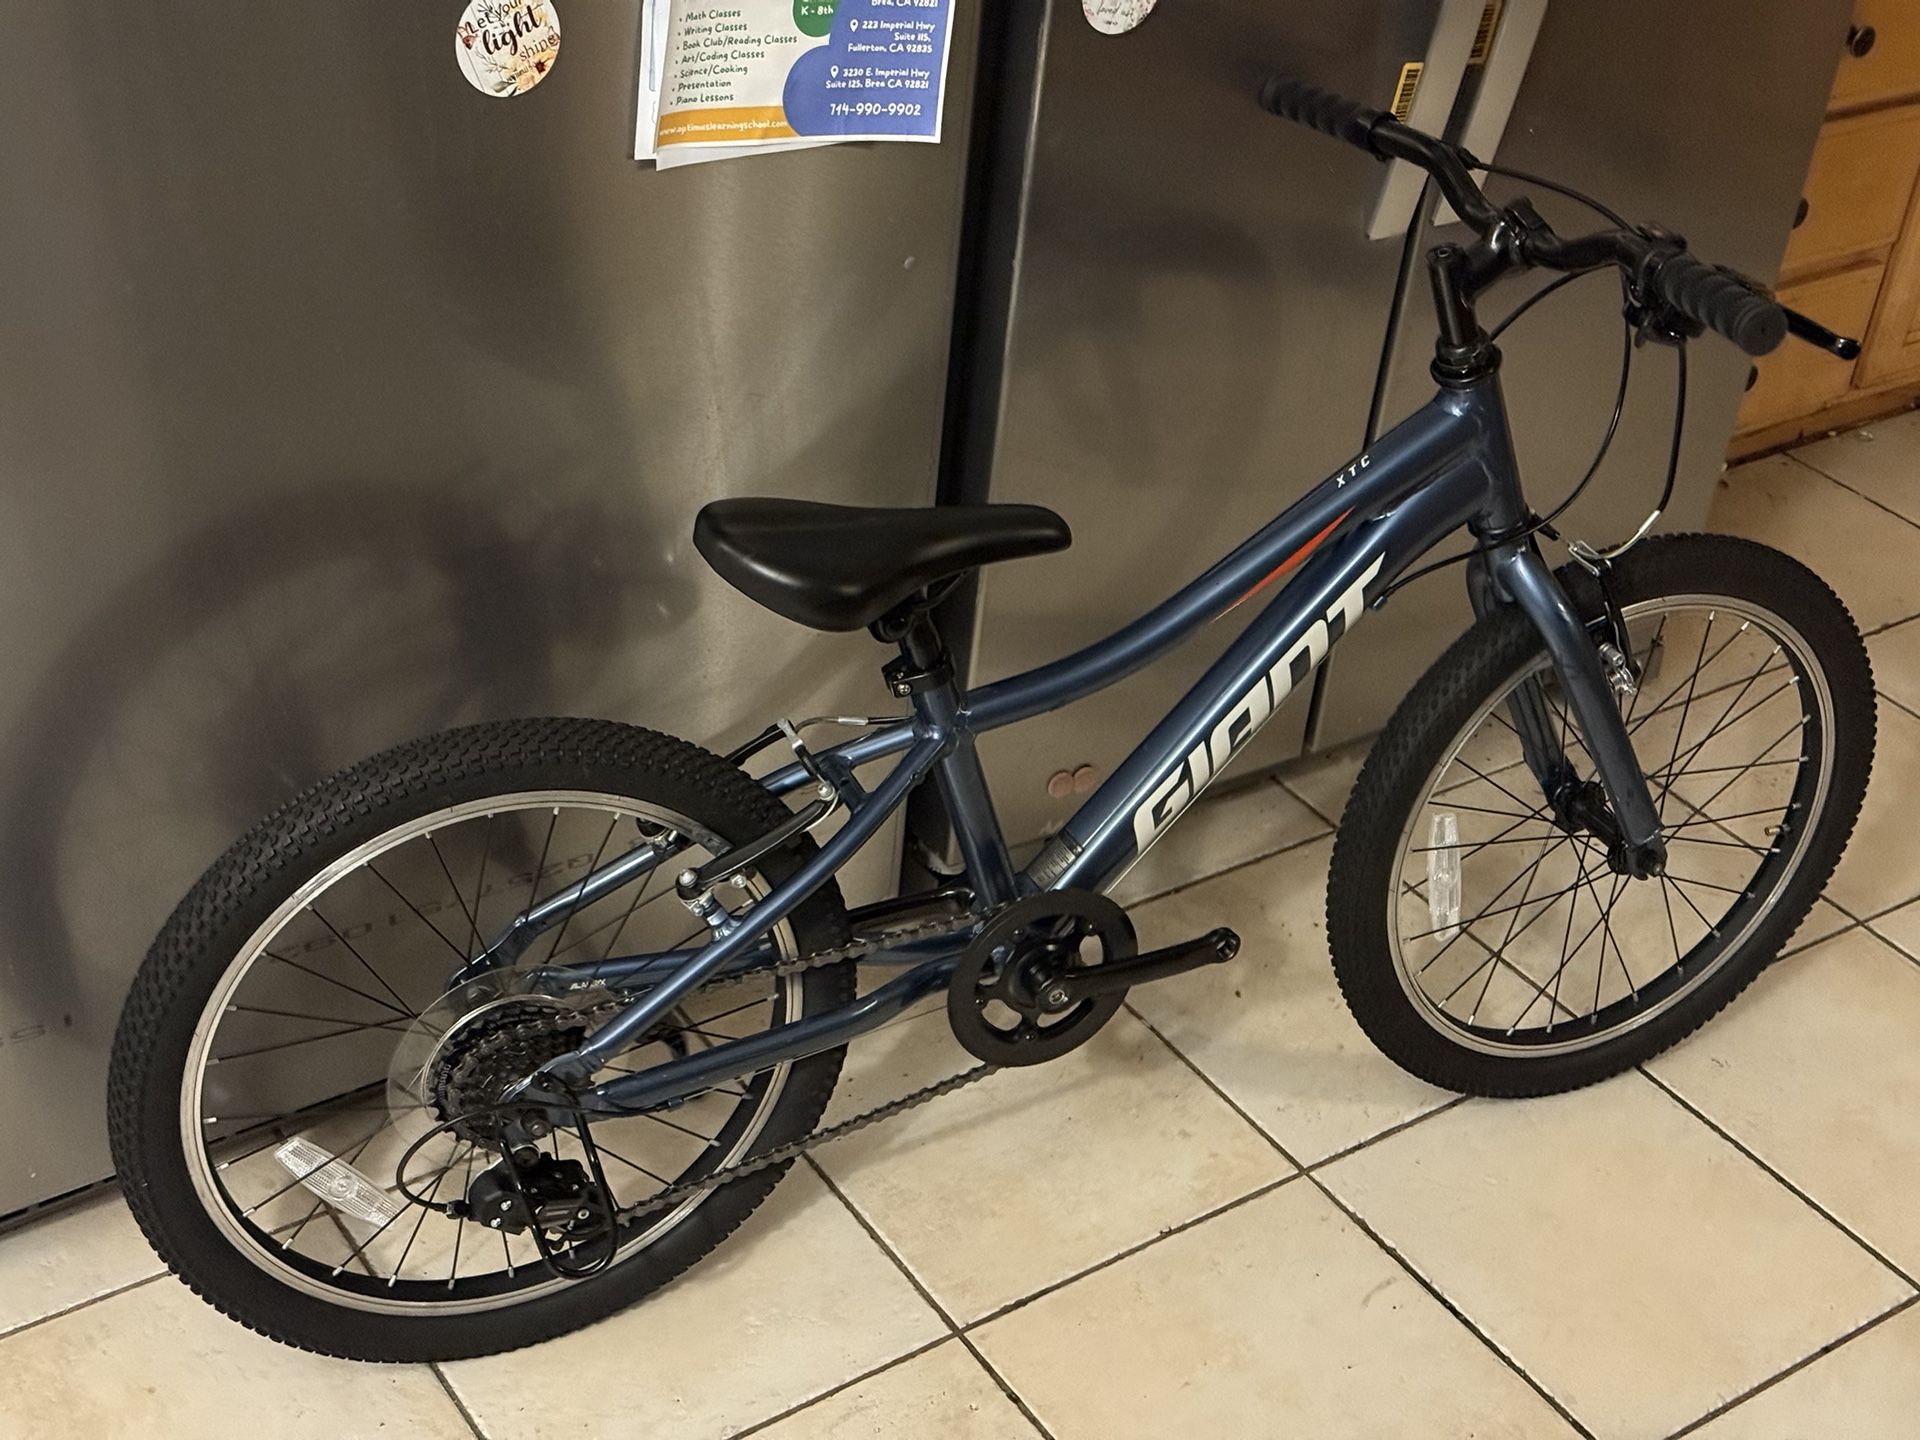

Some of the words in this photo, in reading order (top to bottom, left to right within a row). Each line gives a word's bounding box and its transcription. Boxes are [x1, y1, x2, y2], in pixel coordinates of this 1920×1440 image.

[685, 11, 707, 22] Math
[709, 9, 741, 20] Classes
[801, 5, 809, 15] K
[817, 5, 834, 15] 8th
[482, 4, 543, 56] light
[684, 25, 713, 36] Writing
[715, 23, 748, 33] Classes
[862, 20, 878, 29] 223
[880, 21, 914, 31] Imperial
[915, 21, 935, 33] Hwy
[682, 40, 701, 51] Book
[703, 35, 762, 48] Club/Reading
[764, 34, 798, 44] Classes
[894, 32, 915, 41] Suite
[519, 34, 557, 62] shine
[889, 43, 904, 53] CA
[681, 51, 728, 65] Art/Coding
[731, 49, 765, 60] Classes
[680, 64, 748, 79] Science/Cooking
[842, 68, 864, 77] 3230
[865, 67, 874, 77] E.
[875, 68, 909, 79] Imperial
[911, 68, 930, 80] Hwy
[678, 80, 732, 93] Presentation
[825, 79, 847, 89] Suite
[865, 78, 886, 88] Brea
[887, 79, 903, 89] CA
[904, 80, 929, 89] 92821
[676, 96, 698, 106] Piano
[700, 93, 734, 103] Lessons
[830, 102, 921, 116] 714-990-9902
[1133, 551, 1386, 854] GIANT
